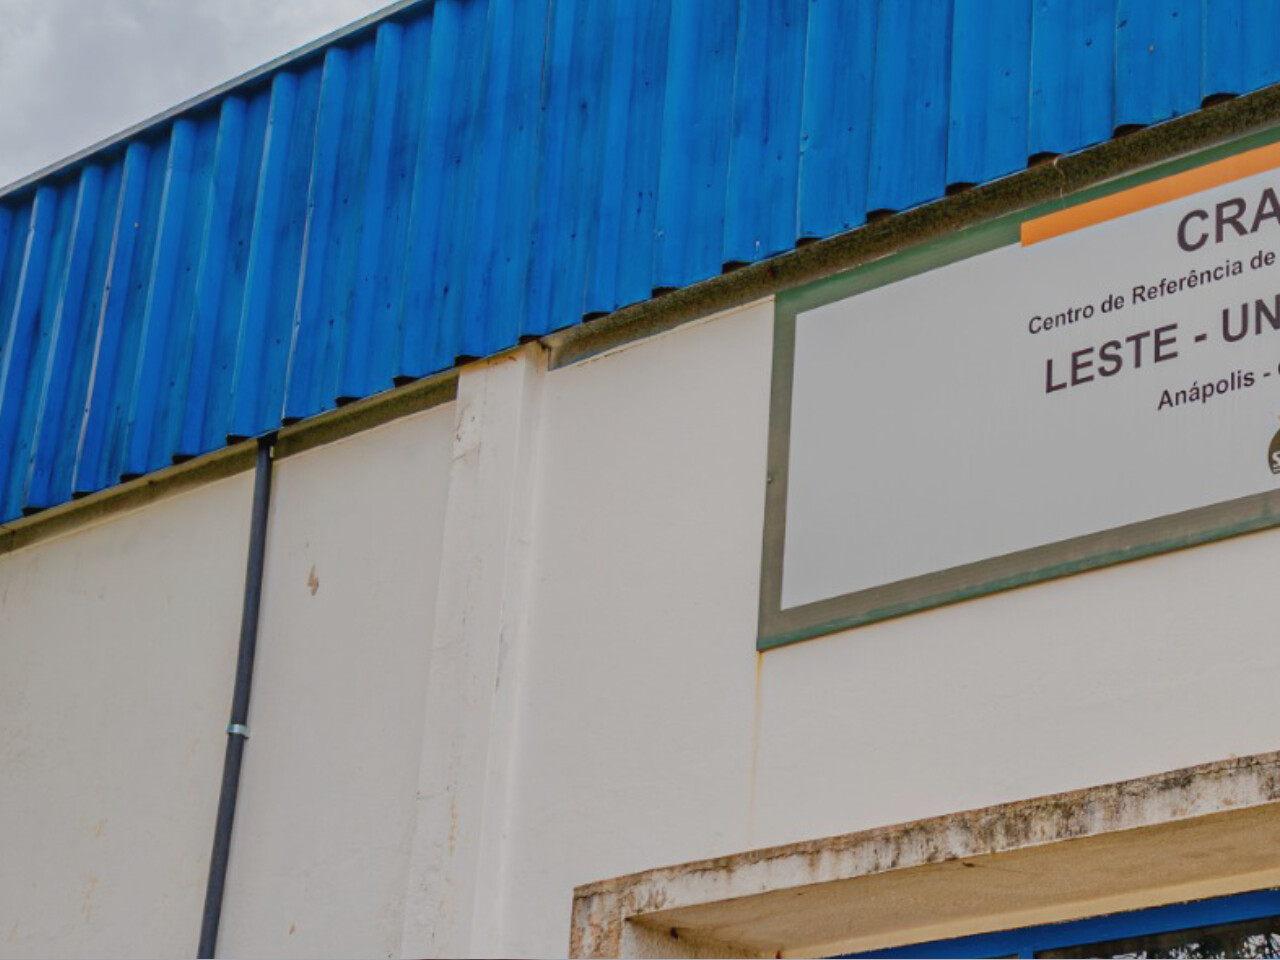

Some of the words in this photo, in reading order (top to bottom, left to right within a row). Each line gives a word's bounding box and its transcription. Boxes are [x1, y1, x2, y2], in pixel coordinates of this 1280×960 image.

[1028, 305, 1095, 335] Centro
[1100, 294, 1125, 314] de
[1132, 259, 1243, 305] Referência
[1249, 250, 1276, 270] de
[1045, 322, 1179, 394] LESTE
[1157, 368, 1256, 411] Anápolis
